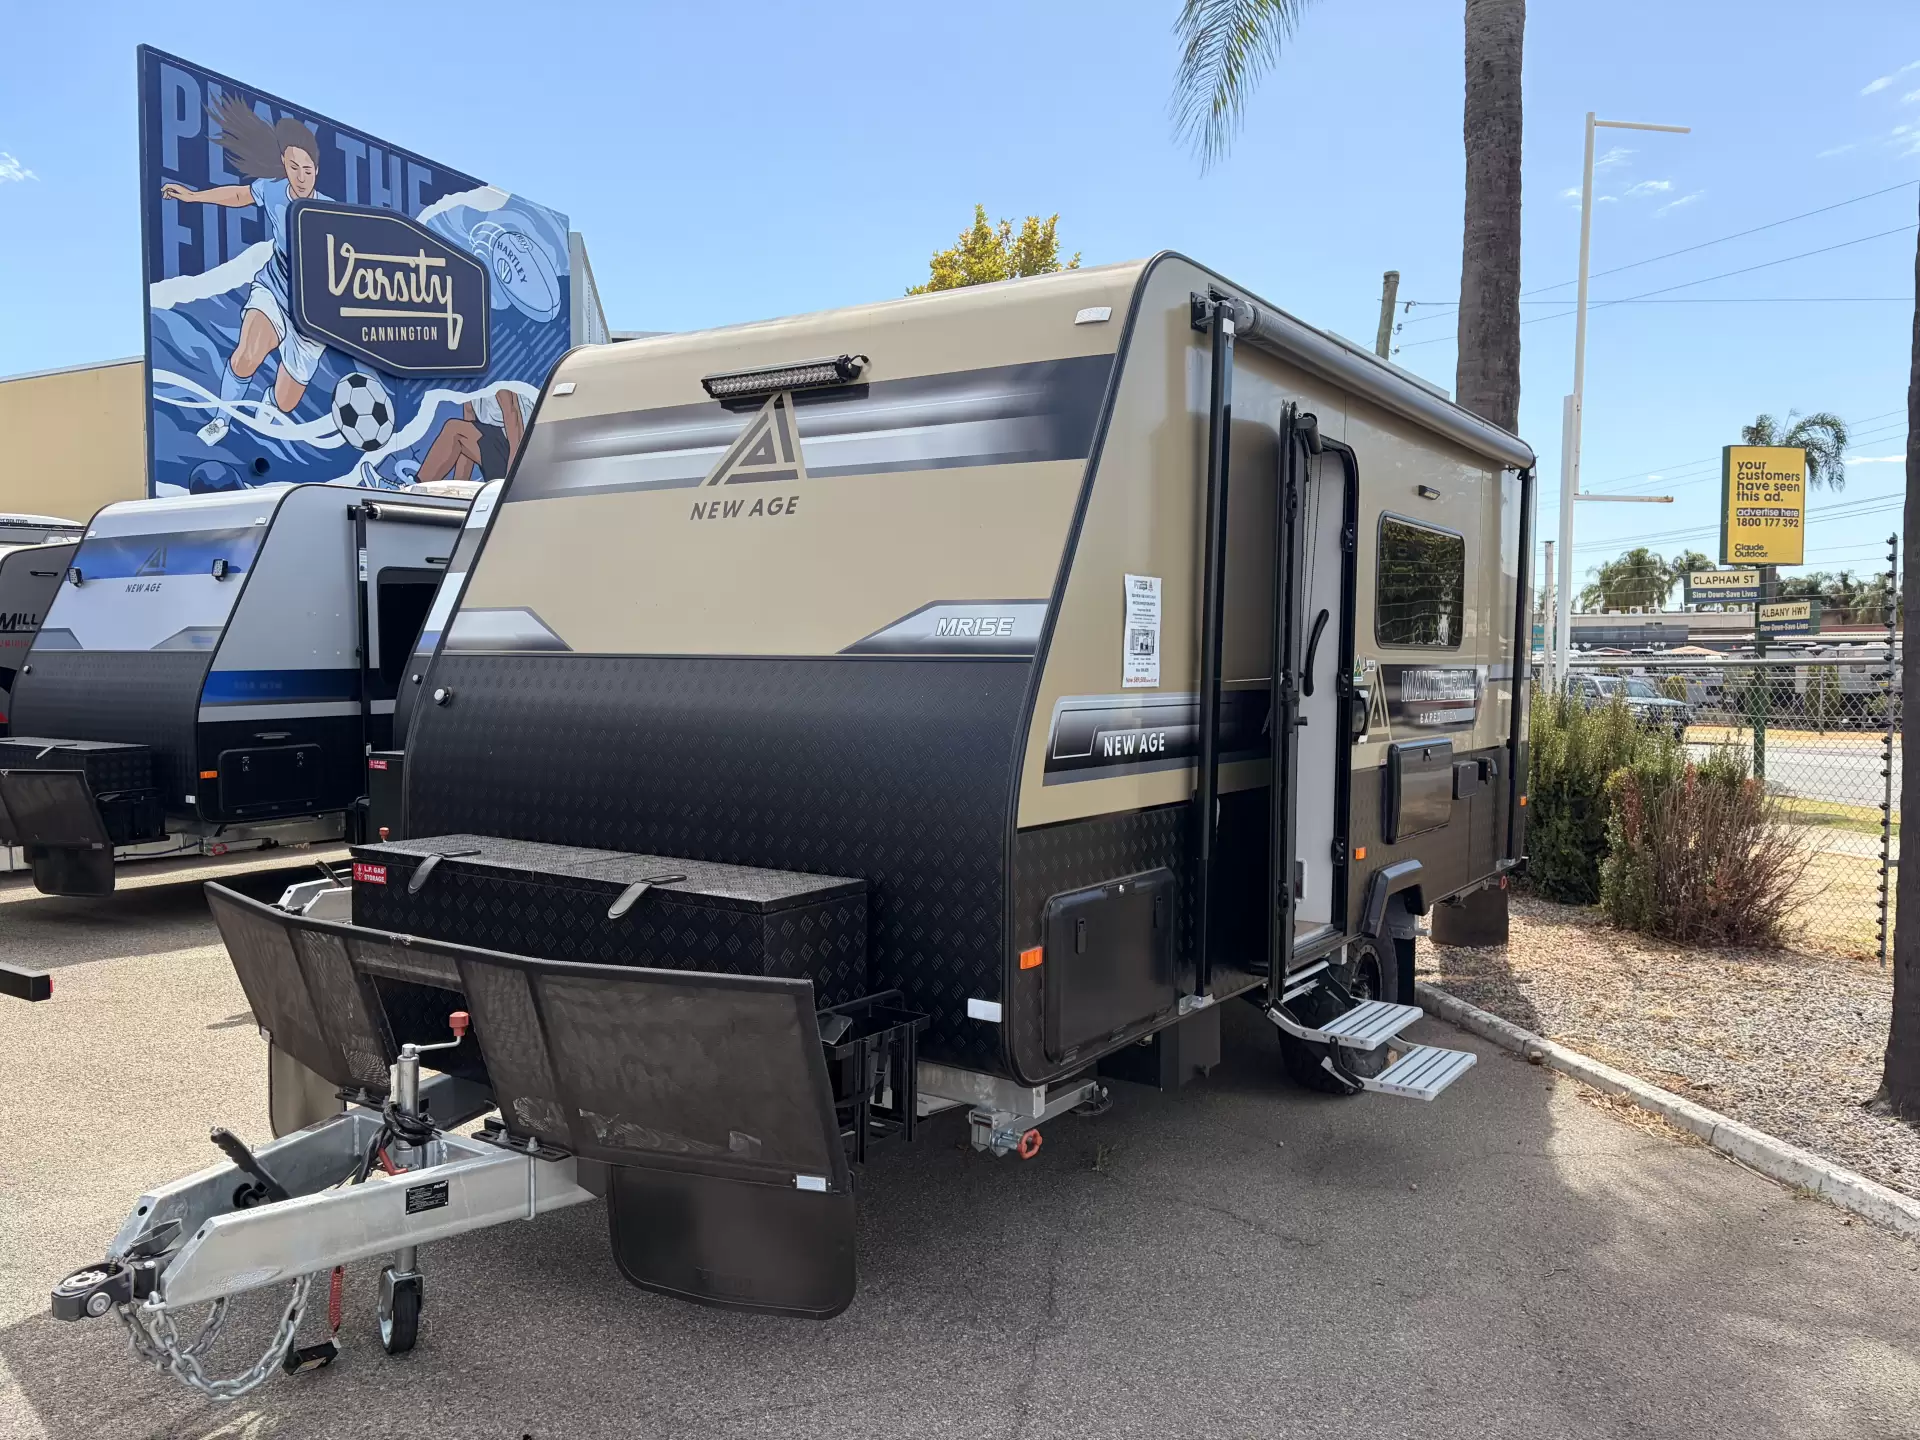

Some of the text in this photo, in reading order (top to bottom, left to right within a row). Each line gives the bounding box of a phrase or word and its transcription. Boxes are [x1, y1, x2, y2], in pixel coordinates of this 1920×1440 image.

[497, 240, 528, 283] HARTLEY
[326, 233, 464, 350] Varsity
[361, 326, 438, 342] CANNINGTON
[1737, 461, 1767, 472] your
[1737, 470, 1800, 482] customers
[1737, 480, 1800, 492] have seen
[1736, 491, 1784, 502] this ad.
[690, 495, 799, 520] NEW AGE
[1737, 508, 1799, 517] advertise here
[1737, 518, 1799, 528] 1800 177 392
[1693, 575, 1755, 585] CLAPHAM ST
[125, 582, 162, 593] NEW AGE
[1692, 591, 1707, 599] Slow
[1741, 590, 1758, 598] Lives
[1761, 606, 1808, 618] ALBANY HWY
[935, 616, 1016, 637] MR15E
[1401, 670, 1446, 702] MANTA
[1104, 732, 1165, 758] NEW AGE
[374, 867, 385, 875] GAS
[364, 874, 385, 883] STORAGE
